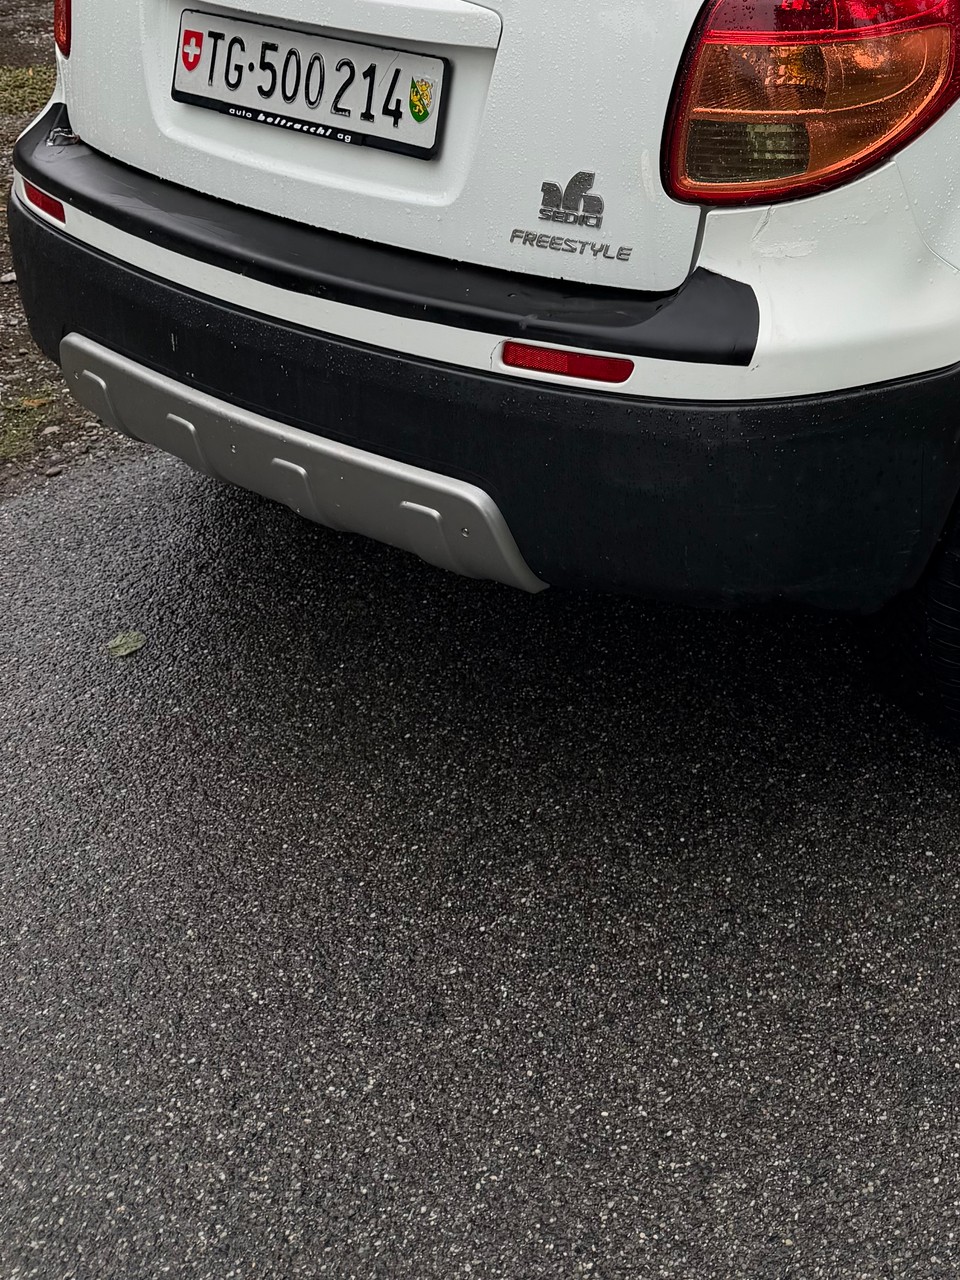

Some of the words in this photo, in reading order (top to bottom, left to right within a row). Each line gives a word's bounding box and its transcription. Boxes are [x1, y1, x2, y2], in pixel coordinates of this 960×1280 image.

[229, 107, 253, 119] auto
[257, 112, 333, 137] beltracchi
[336, 131, 352, 143] ag
[538, 208, 604, 228] SEDICI
[509, 228, 633, 262] FREESTYLE
